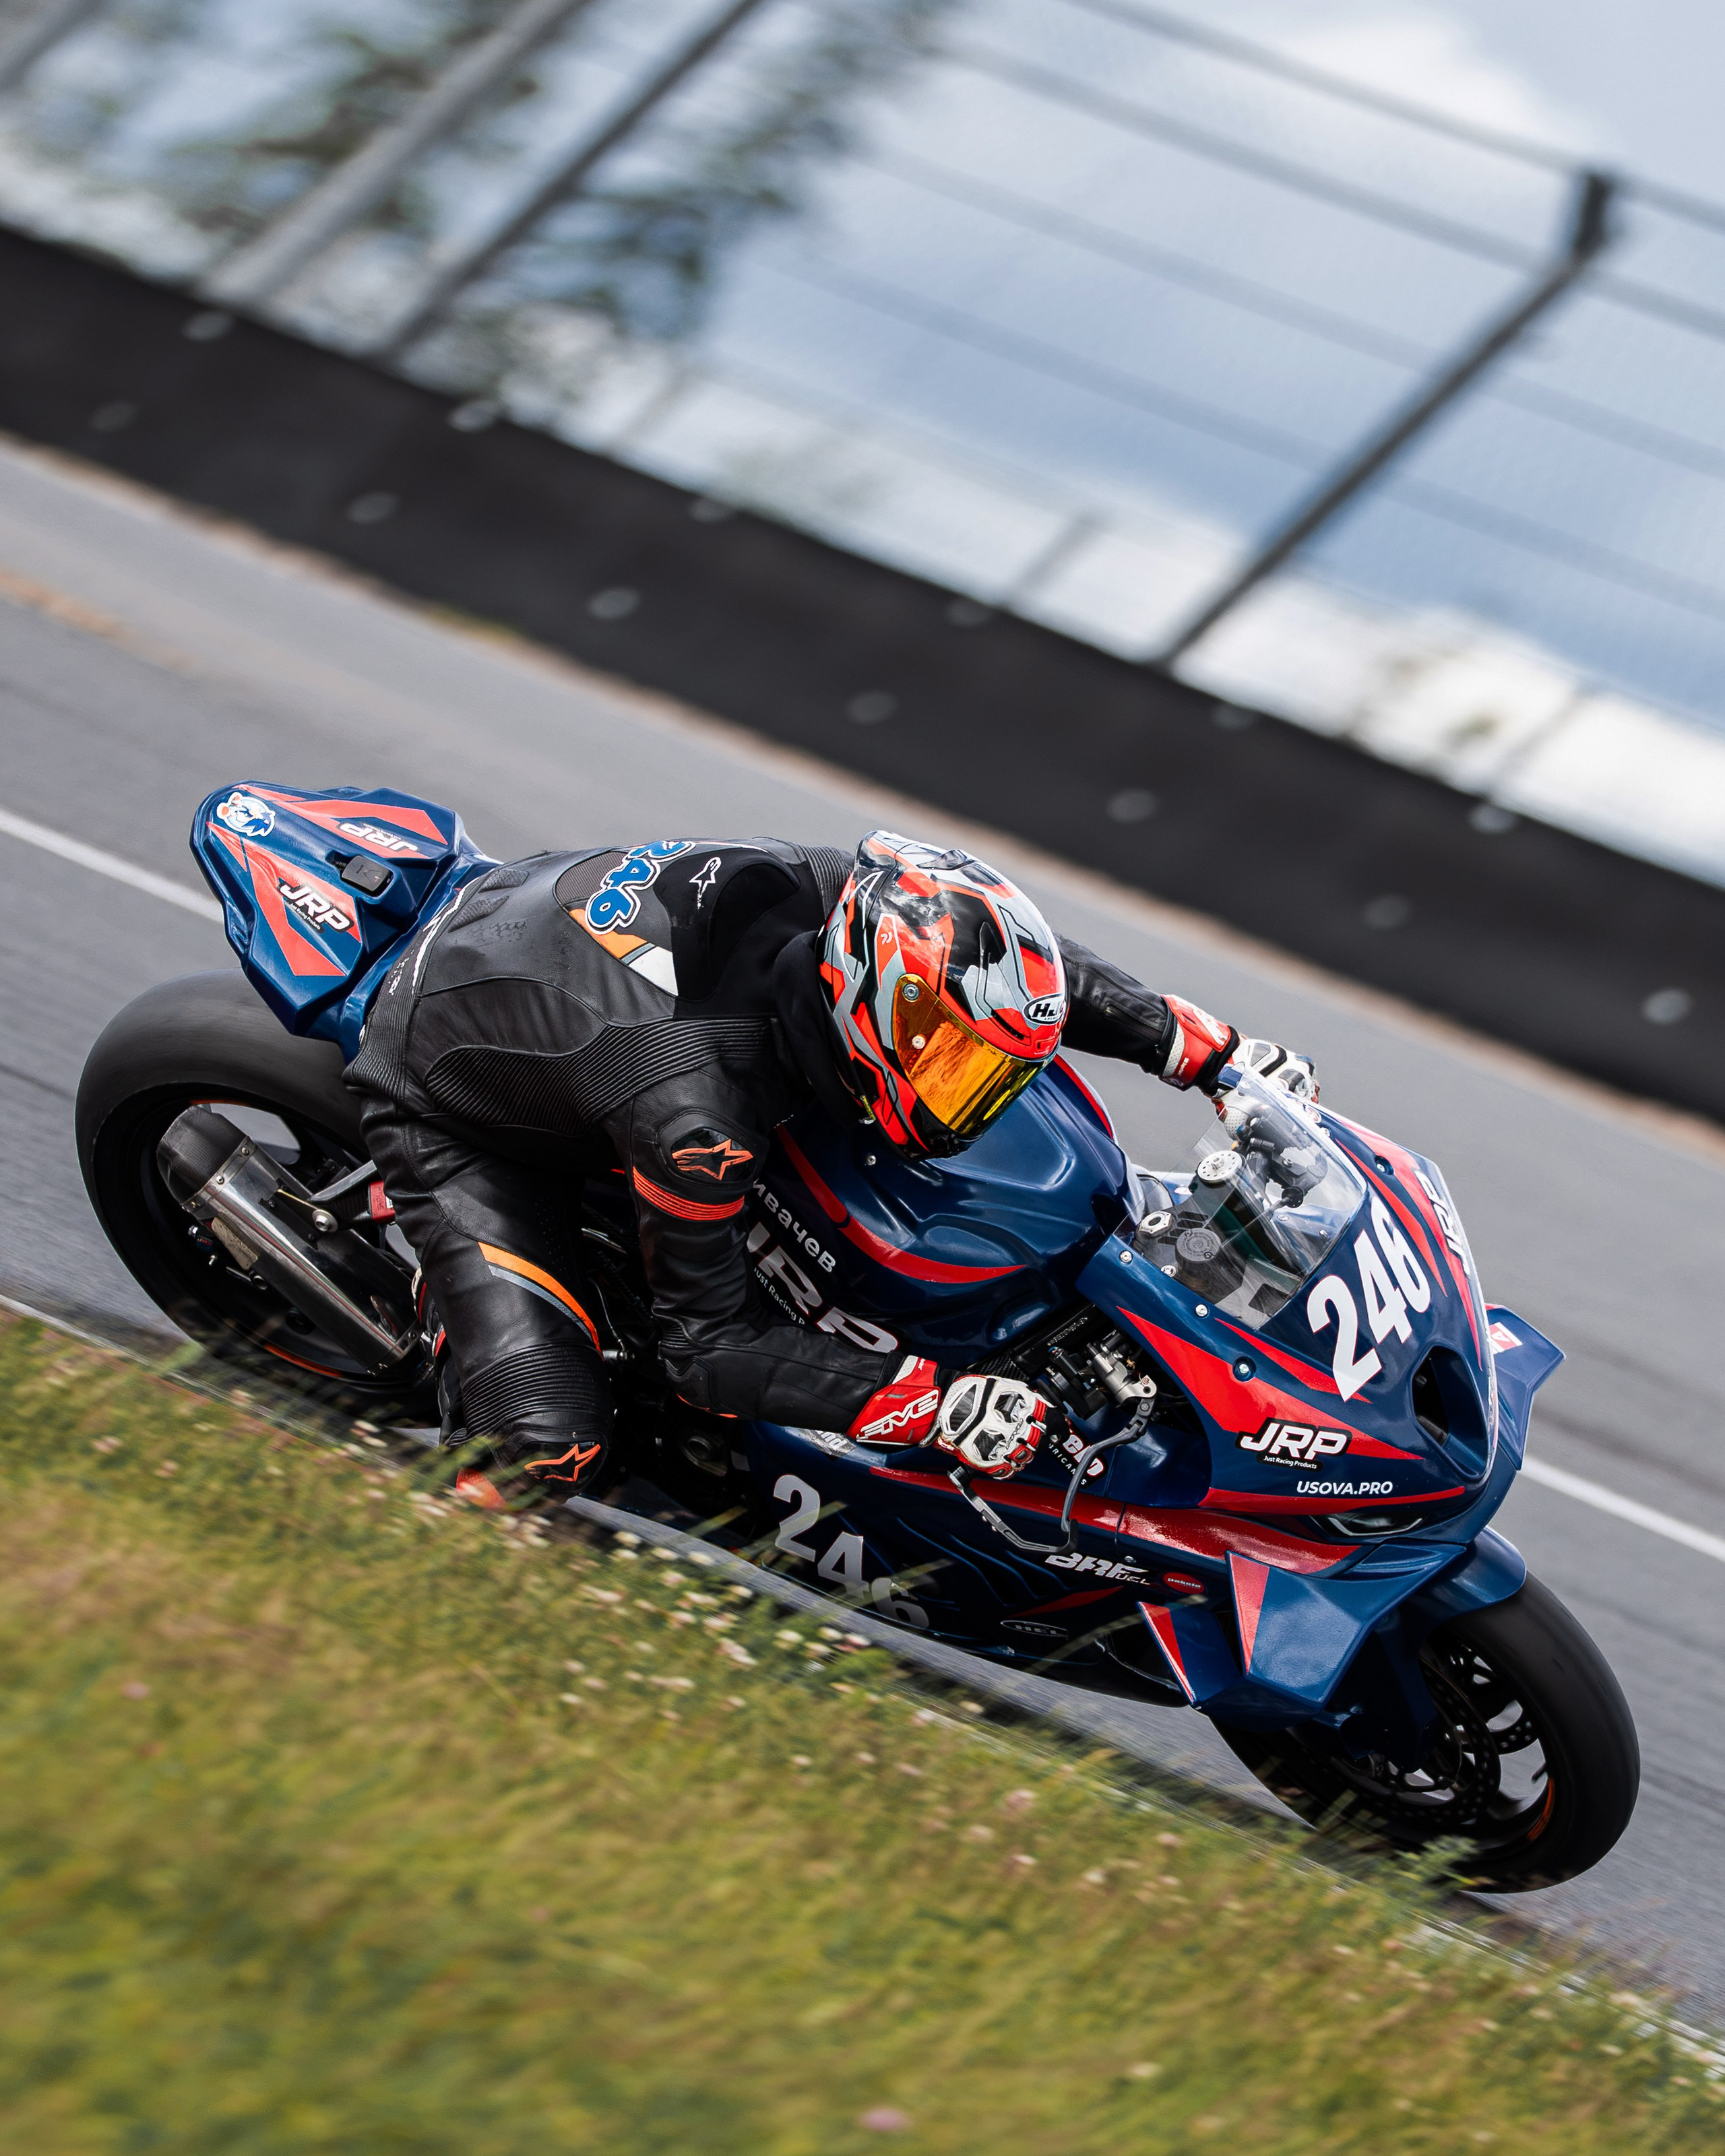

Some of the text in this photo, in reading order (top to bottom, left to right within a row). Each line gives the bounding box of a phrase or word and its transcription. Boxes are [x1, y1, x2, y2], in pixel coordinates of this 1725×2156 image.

[340, 823, 418, 852] JRP
[280, 885, 350, 930] JRP
[1415, 1171, 1470, 1275] JRP
[768, 1284, 797, 1321] Racing
[1307, 1197, 1431, 1402] 246
[1241, 1422, 1348, 1461] JRP
[1276, 1457, 1294, 1467] Racing
[1294, 1460, 1317, 1469] Products
[1296, 1481, 1393, 1494] USOVA.PRO
[773, 1474, 929, 1629] 246
